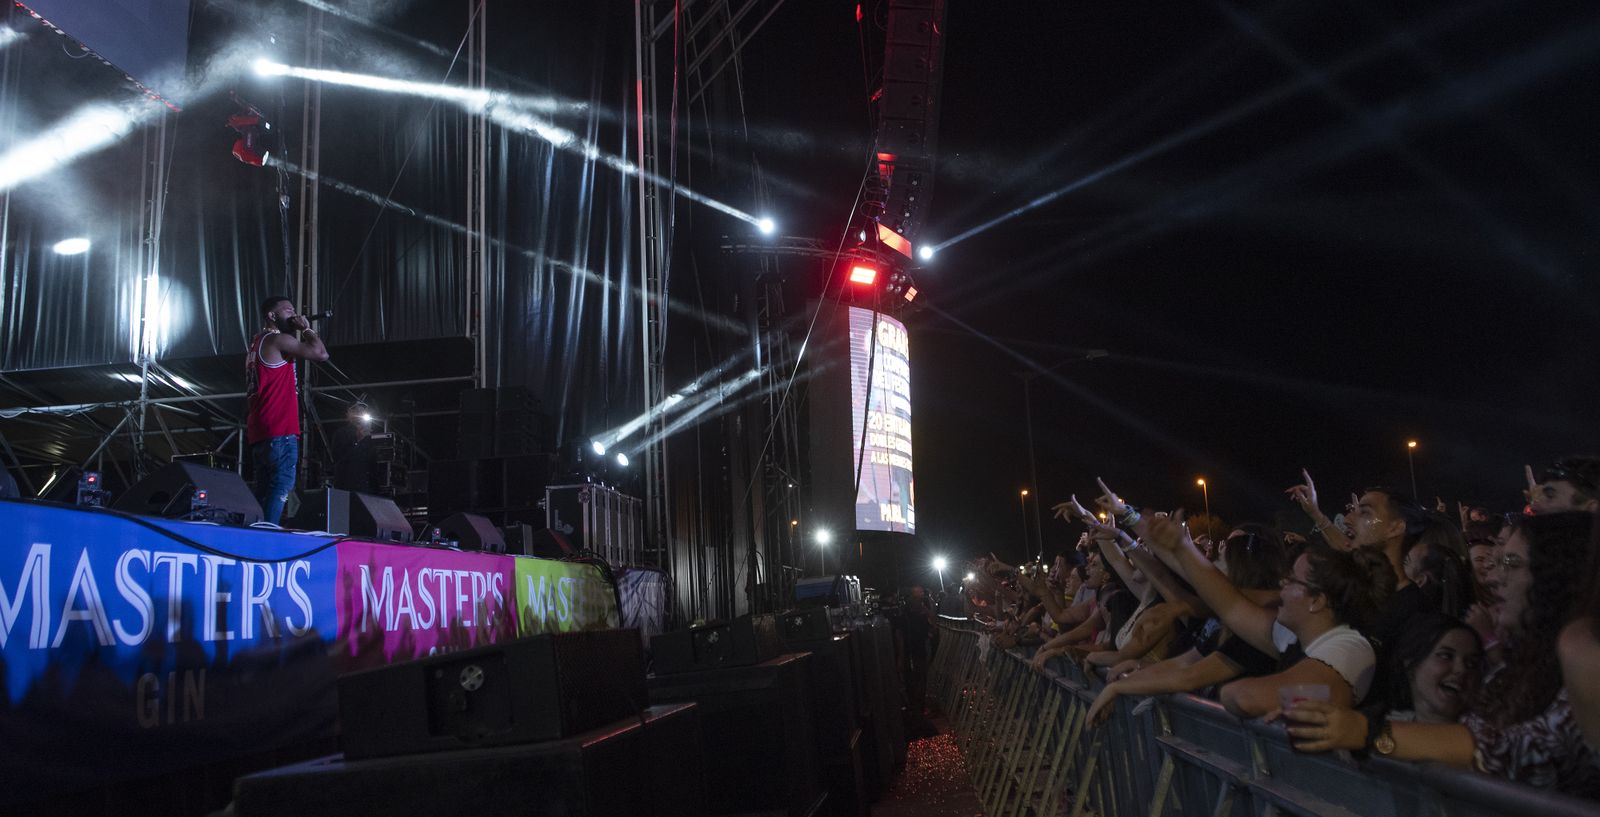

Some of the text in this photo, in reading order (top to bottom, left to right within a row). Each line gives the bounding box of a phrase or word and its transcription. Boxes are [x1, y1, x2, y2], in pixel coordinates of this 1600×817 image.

[868, 410, 882, 430] 20
[359, 564, 504, 633] MASTER'S
[136, 667, 207, 729] GIN
